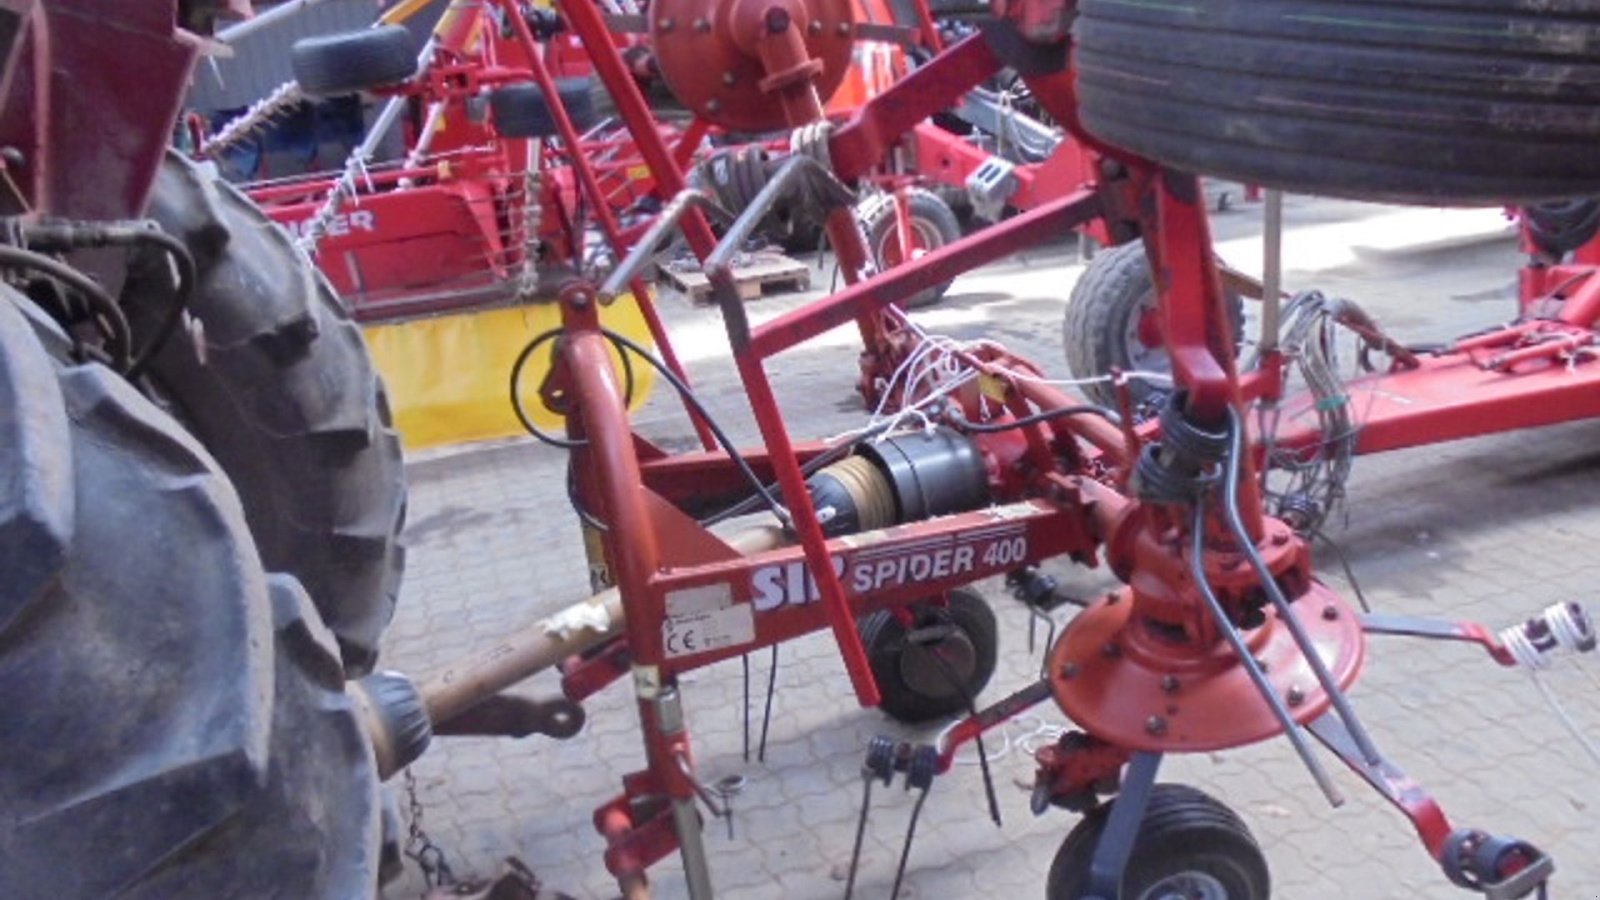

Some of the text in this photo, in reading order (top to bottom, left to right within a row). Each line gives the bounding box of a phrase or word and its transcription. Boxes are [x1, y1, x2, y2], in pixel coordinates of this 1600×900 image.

[753, 537, 1027, 611] SI SPIDER 400
